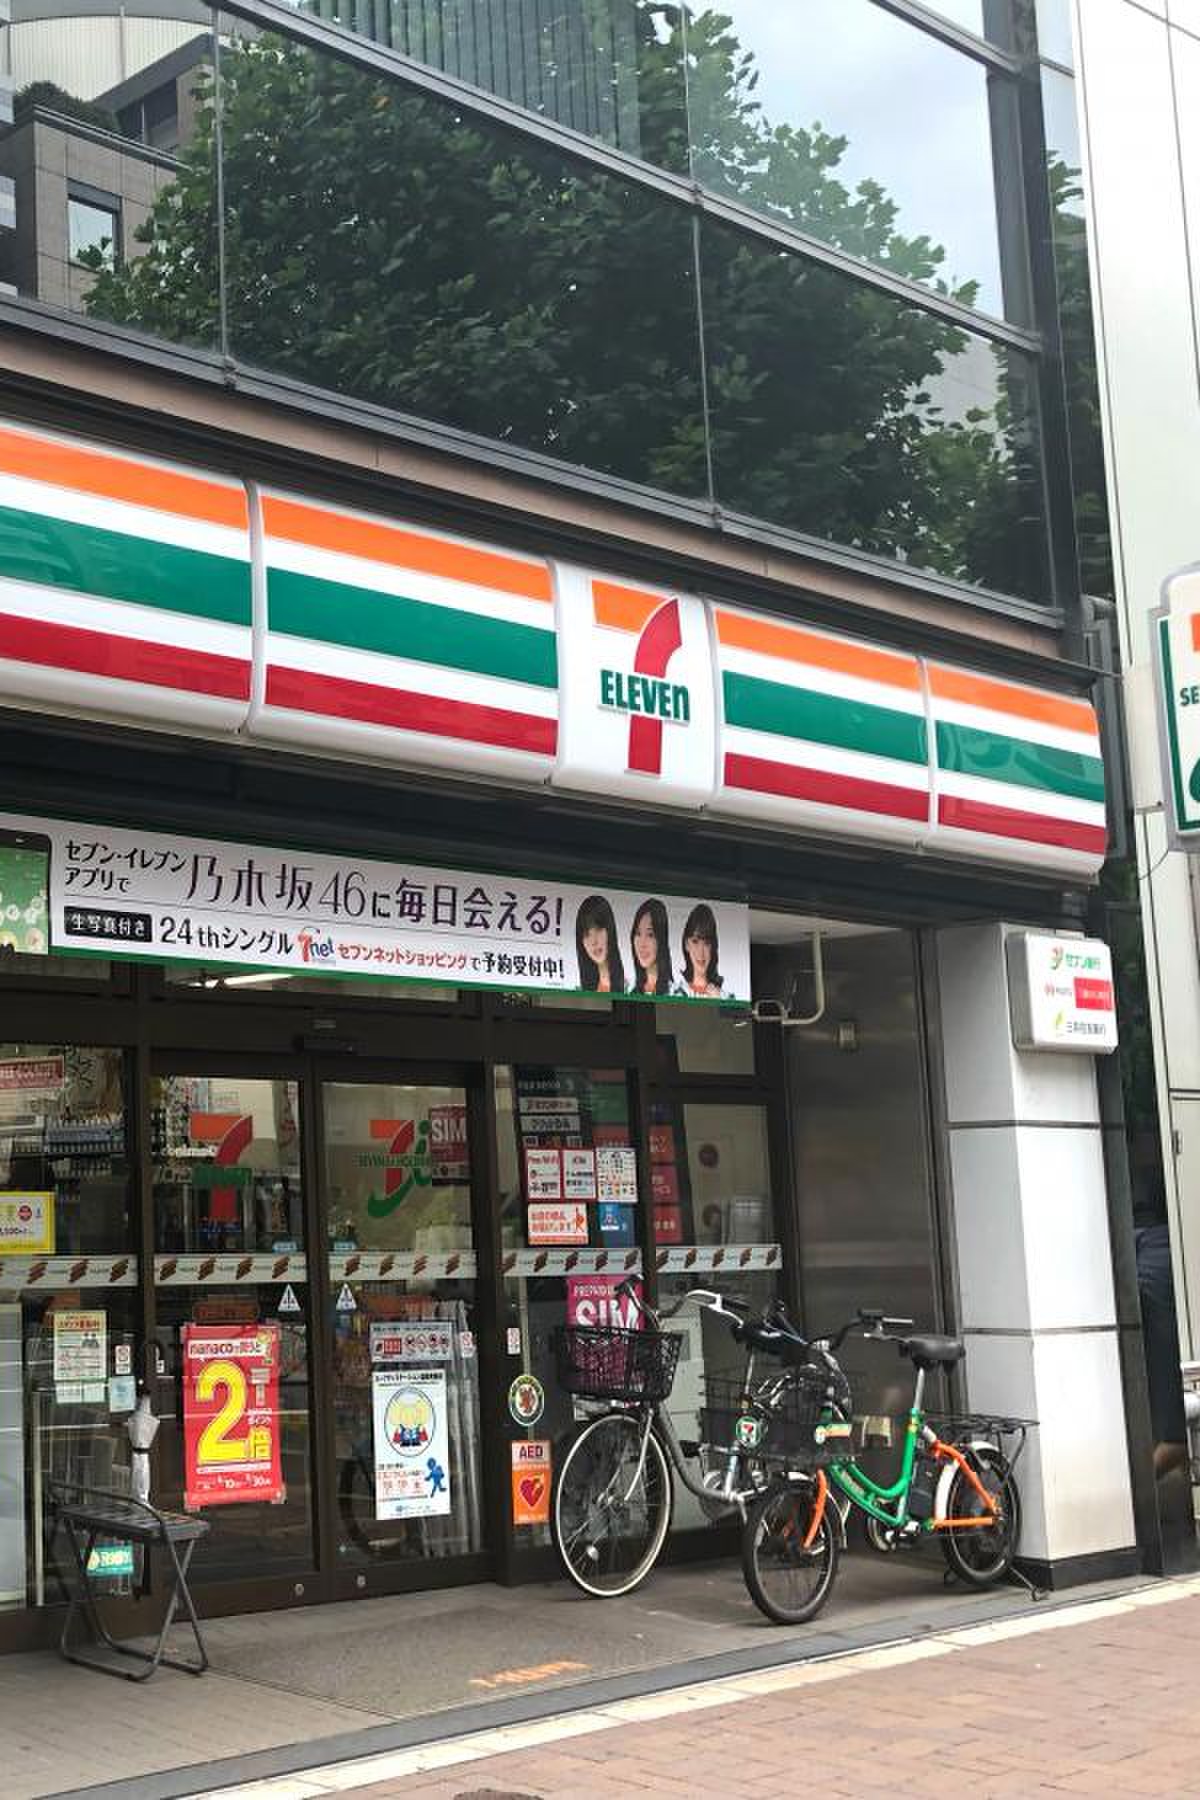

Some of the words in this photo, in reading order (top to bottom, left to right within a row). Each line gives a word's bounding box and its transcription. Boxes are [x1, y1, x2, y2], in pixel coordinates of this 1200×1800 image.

[65, 840, 186, 872] セブン・イレブン
[64, 867, 132, 893] アプリで
[519, 1445, 544, 1459] AED
